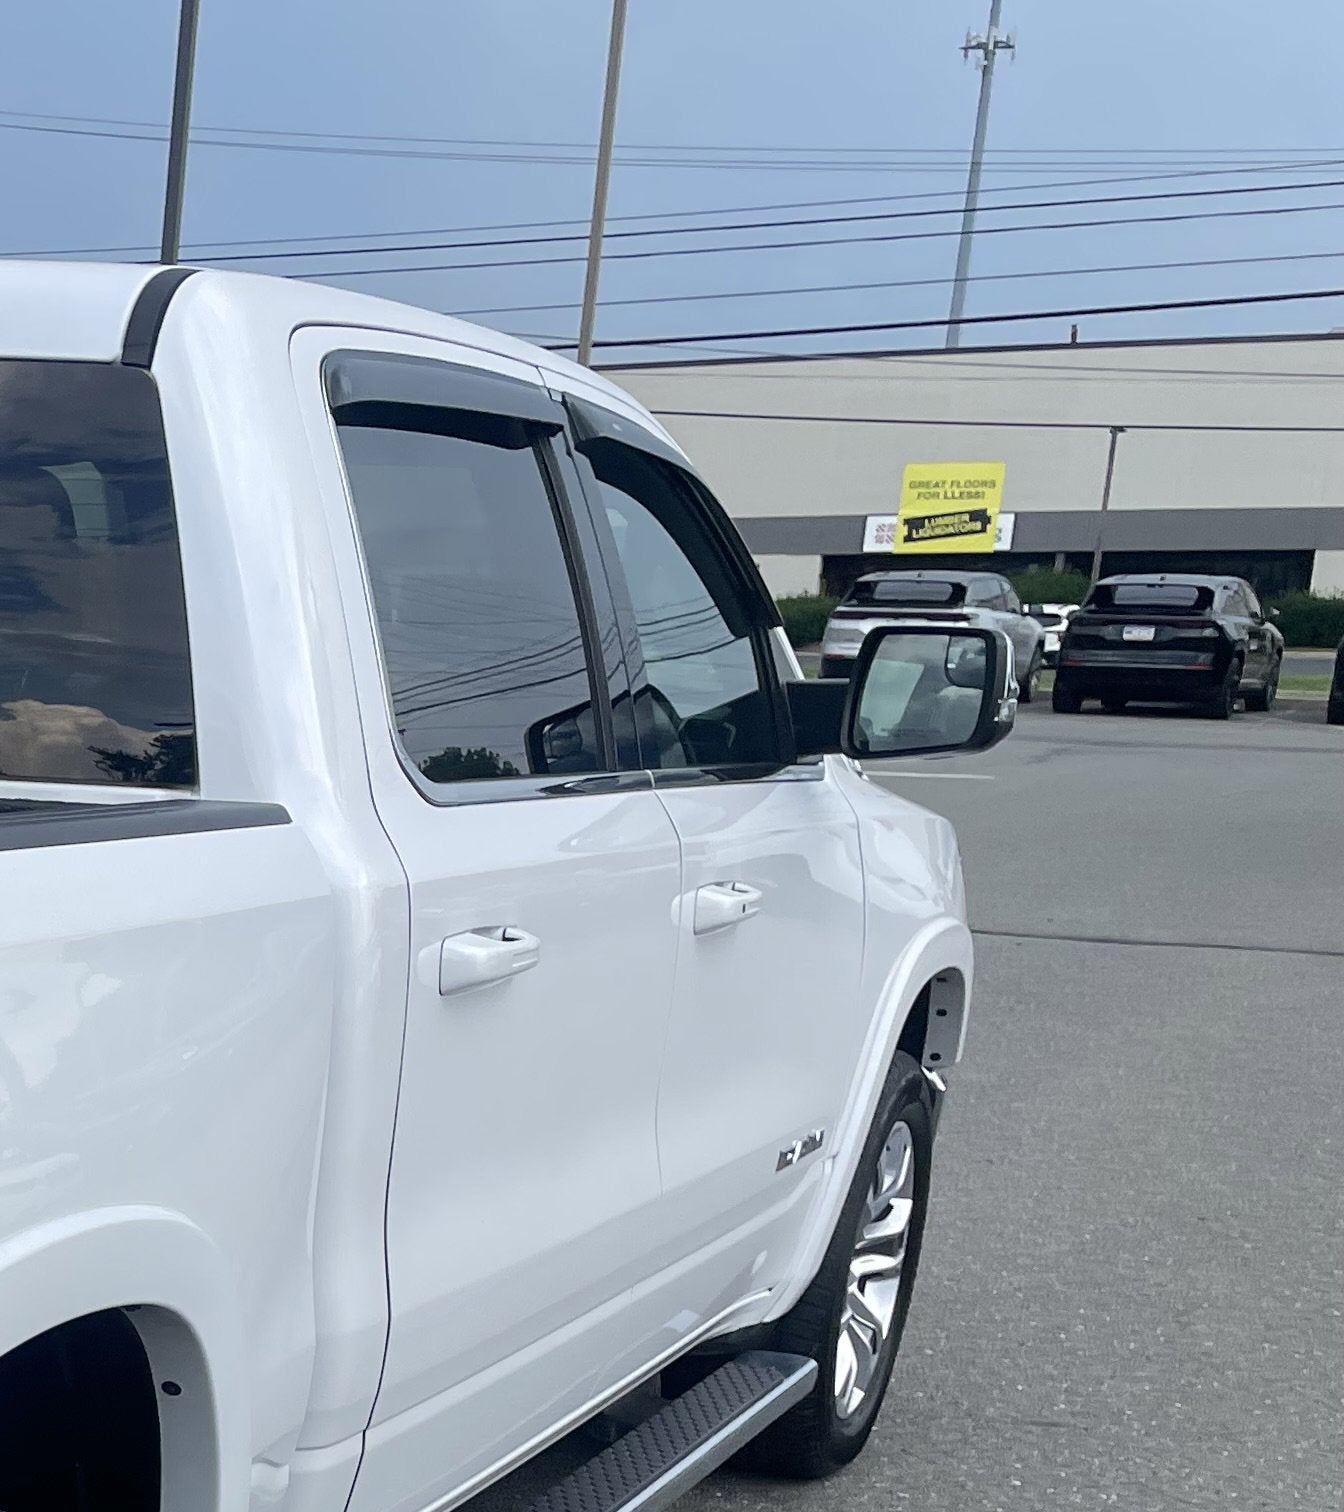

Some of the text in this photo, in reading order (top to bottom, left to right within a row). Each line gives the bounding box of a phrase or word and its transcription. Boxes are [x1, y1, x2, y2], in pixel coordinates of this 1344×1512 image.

[909, 479, 996, 489] GREAT FLOORS
[917, 491, 940, 500] FOR
